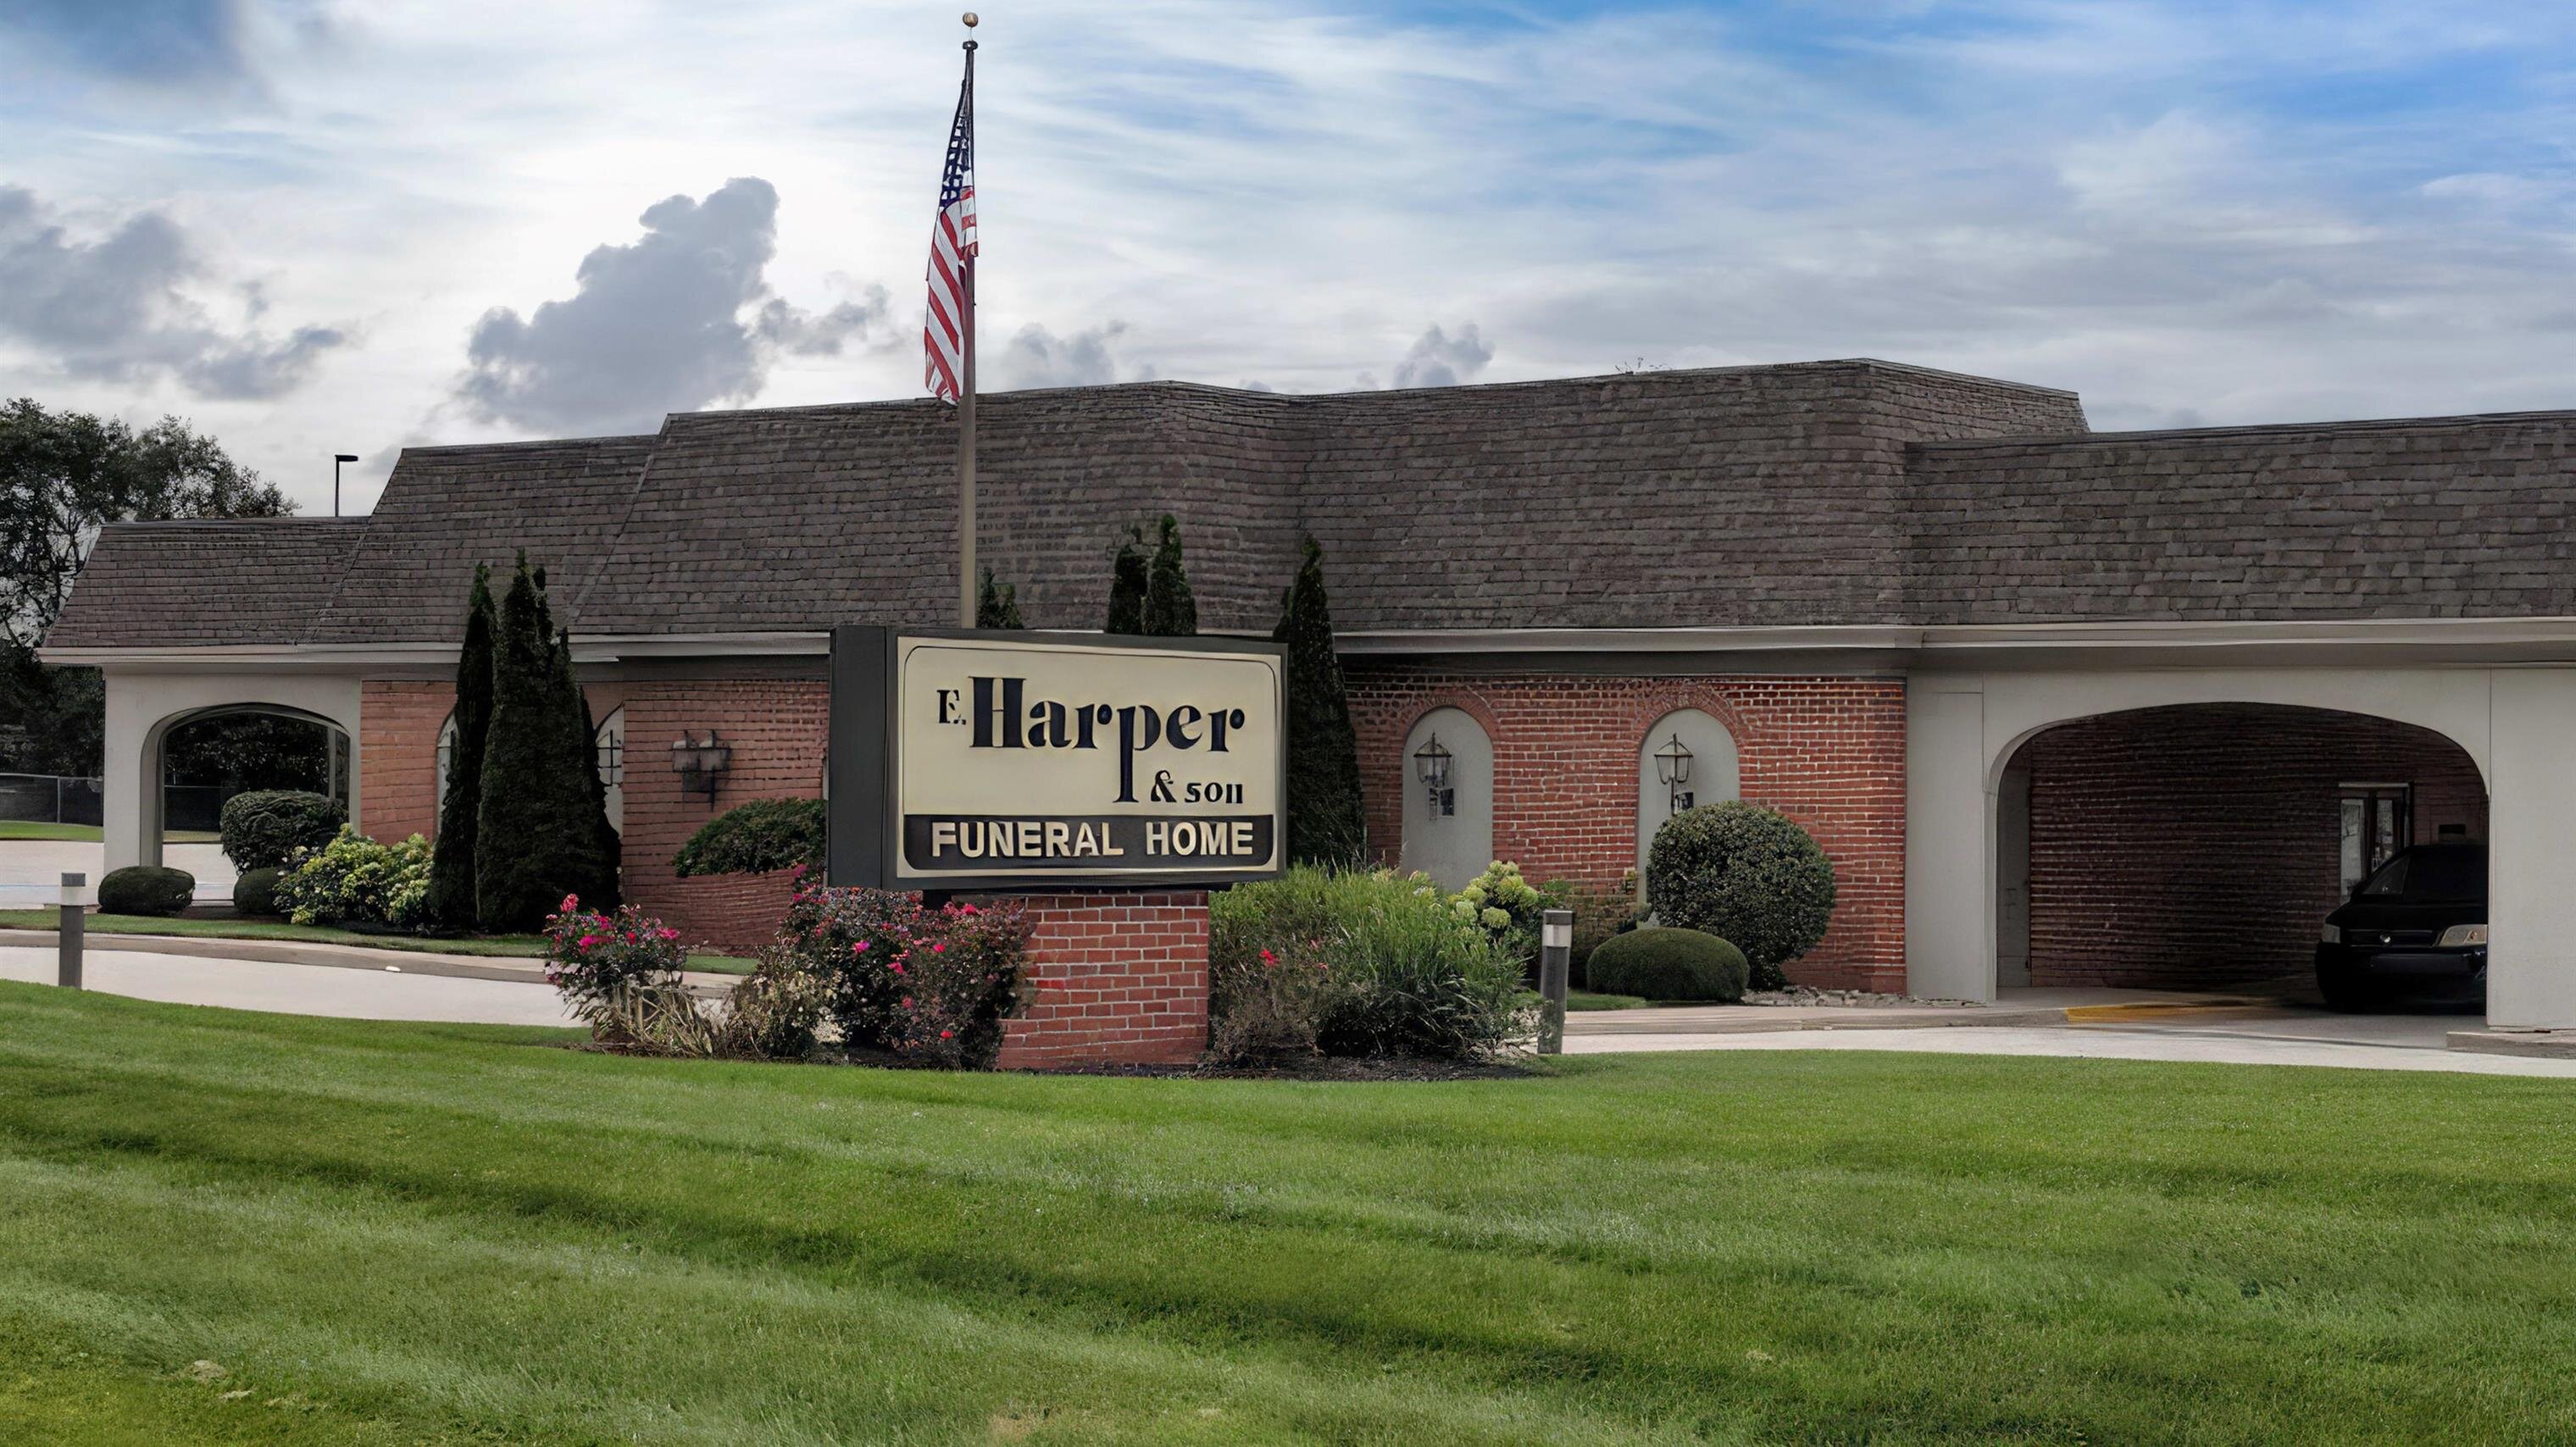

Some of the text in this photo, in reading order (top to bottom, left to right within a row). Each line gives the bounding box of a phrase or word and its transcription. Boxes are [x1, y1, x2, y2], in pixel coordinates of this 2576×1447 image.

[968, 676, 1246, 804] Harper
[1150, 769, 1244, 804] & son
[931, 820, 1254, 858] FUNERAL HOME
